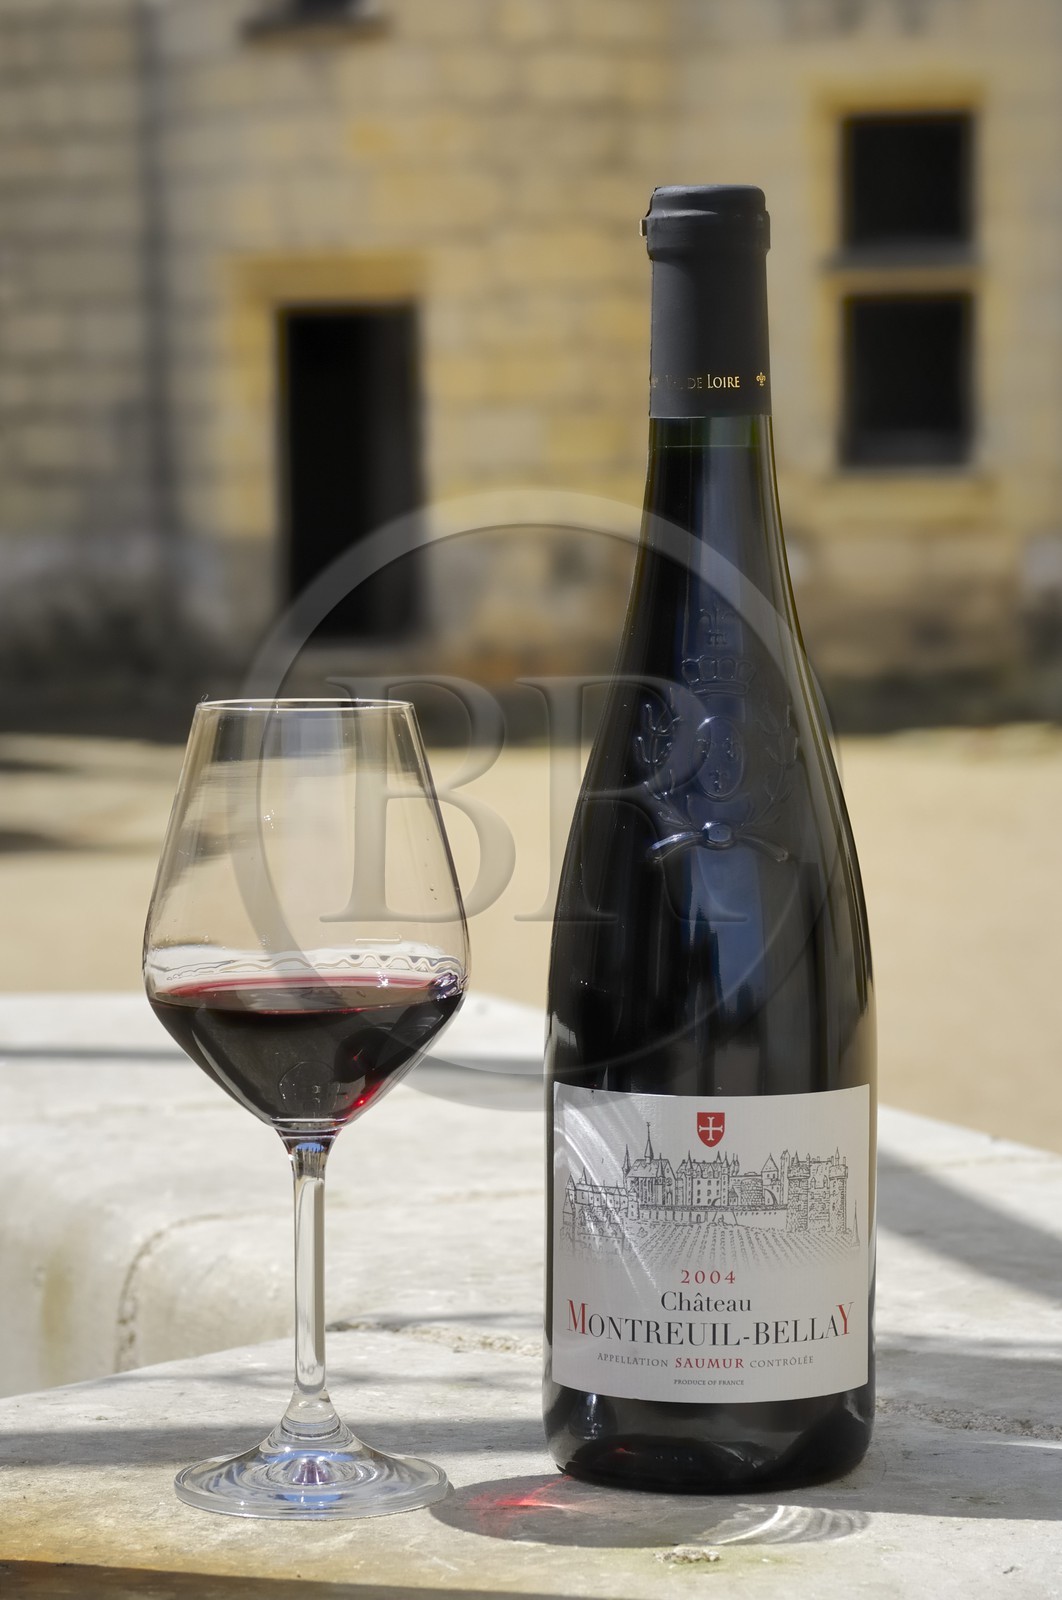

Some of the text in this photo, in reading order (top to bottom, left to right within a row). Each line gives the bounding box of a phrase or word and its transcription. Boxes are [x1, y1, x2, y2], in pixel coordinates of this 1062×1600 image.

[687, 377, 702, 389] DE
[708, 373, 740, 389] LOIRE
[681, 1269, 736, 1284] 2004
[660, 1291, 752, 1312] Château
[567, 1299, 854, 1346] MONTREUIL-BELLAY
[597, 1353, 813, 1369] APPELLATION SAUMUR CONTRÔLÉE
